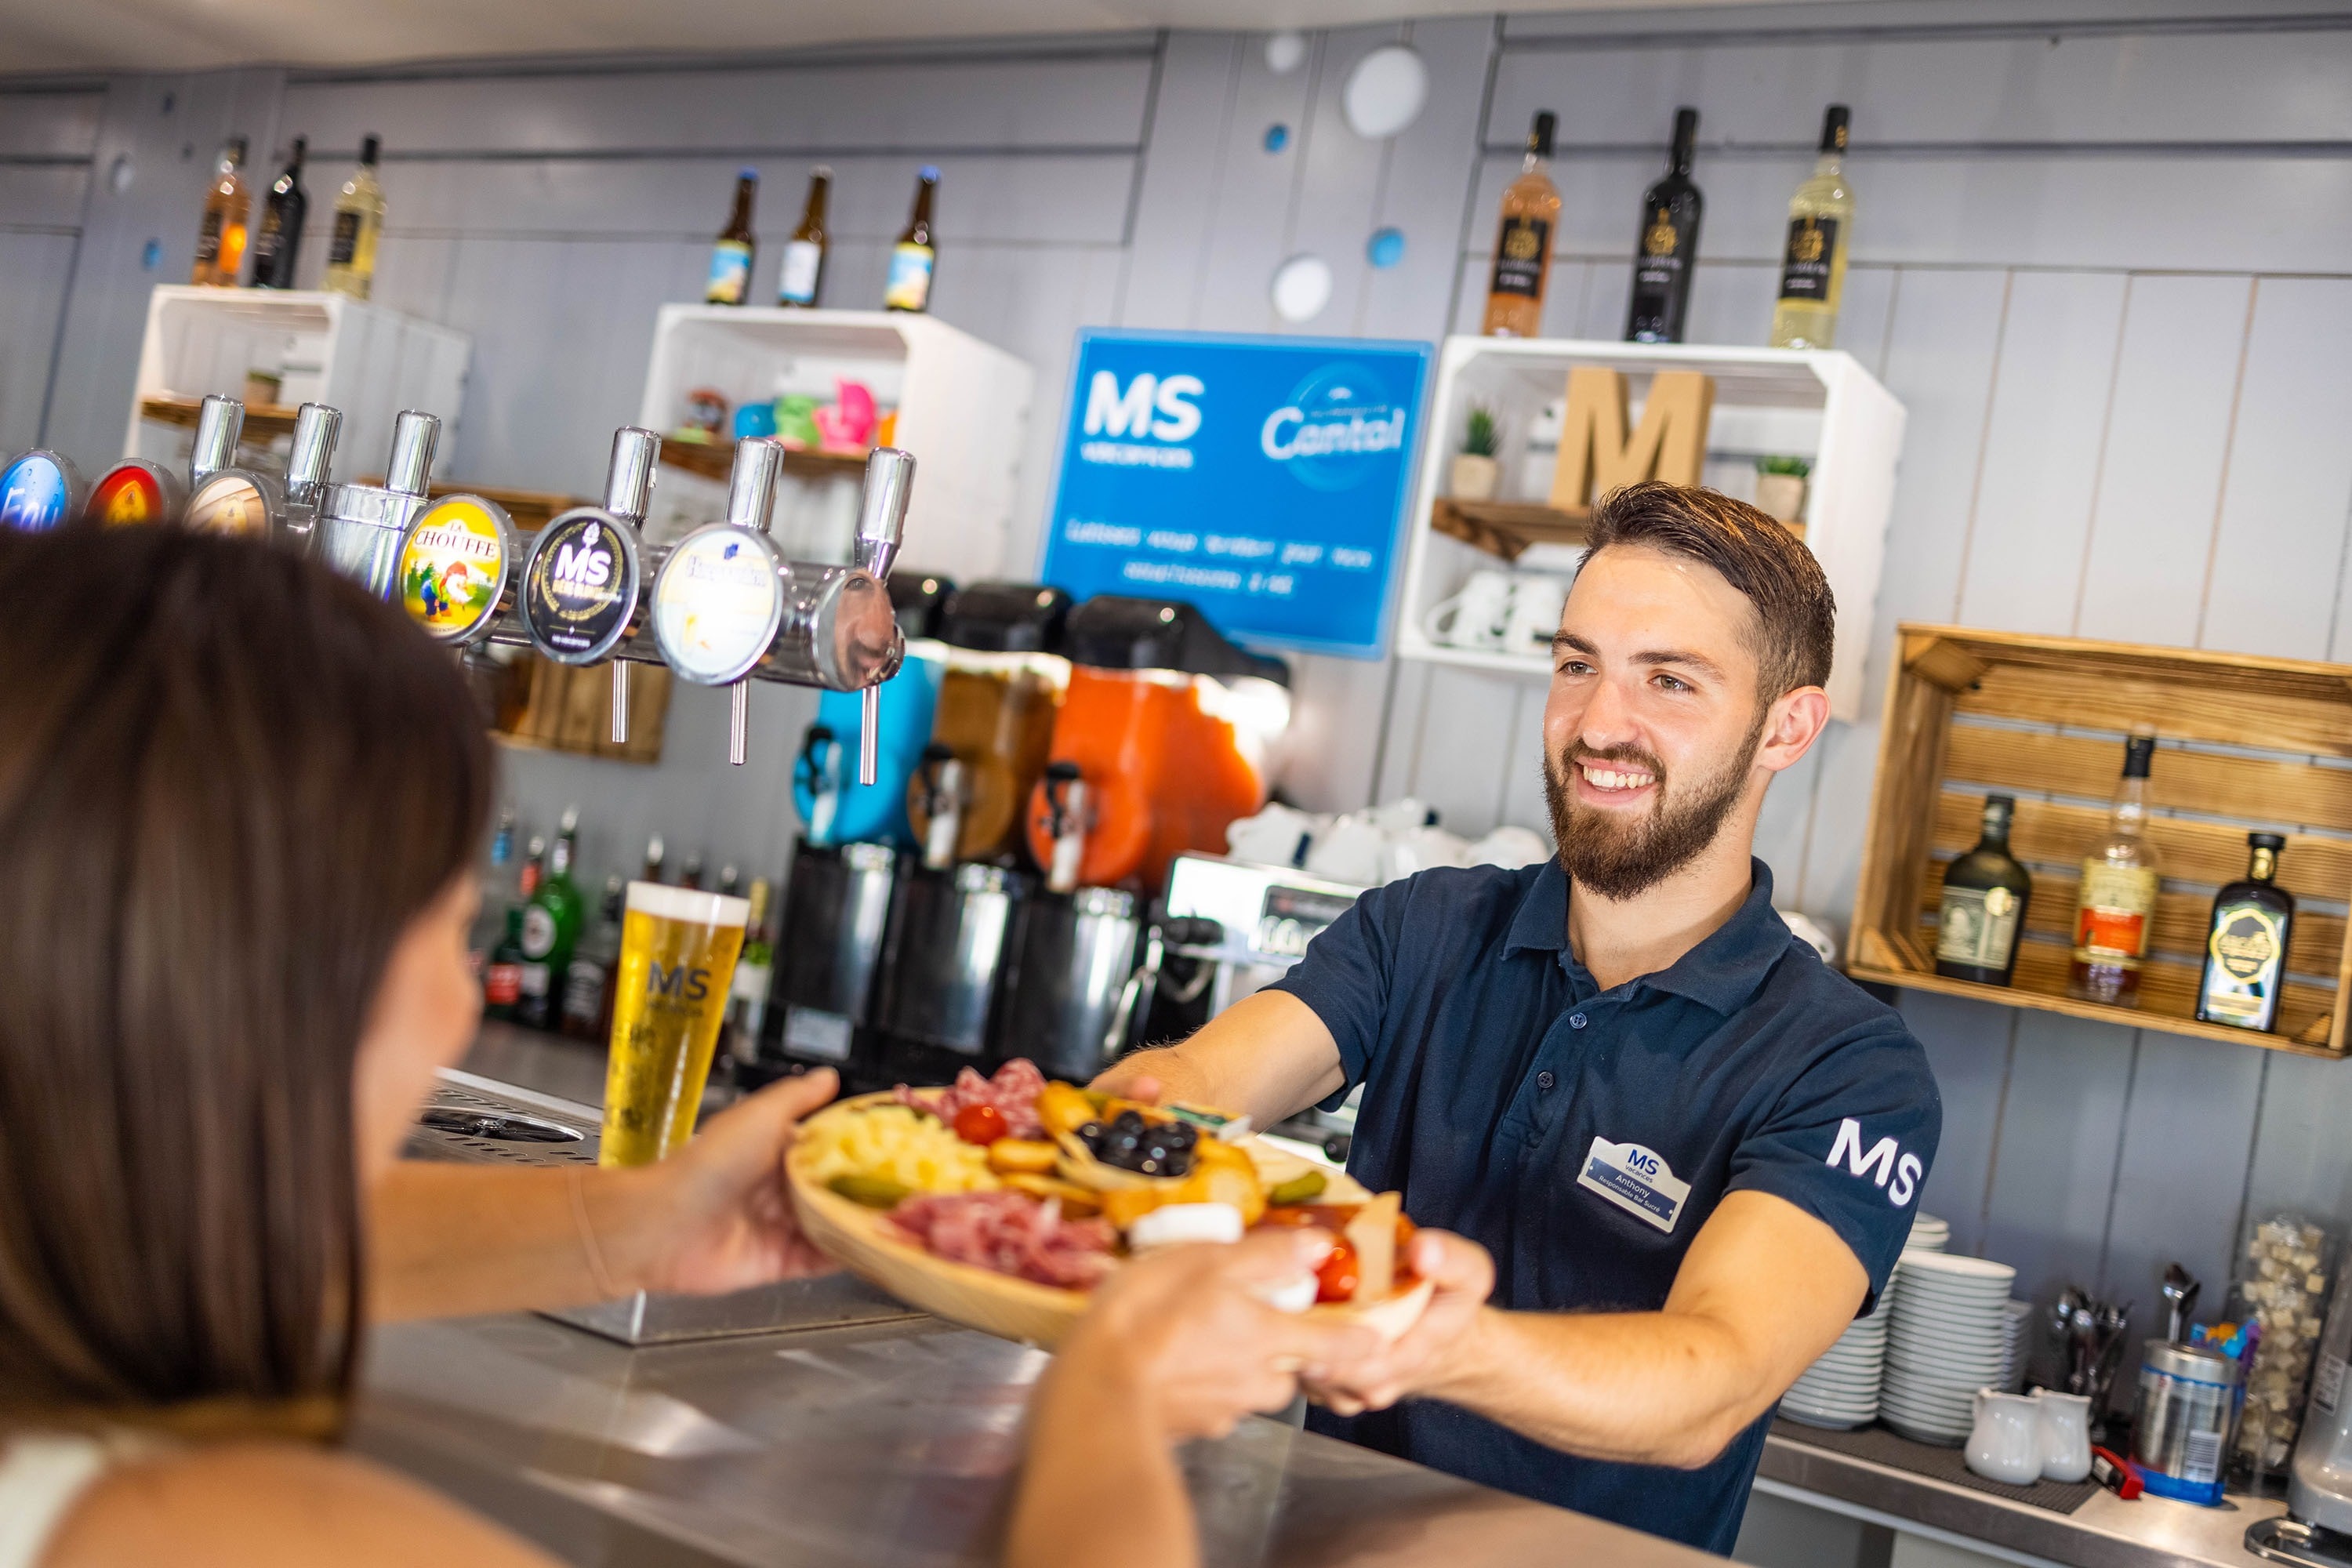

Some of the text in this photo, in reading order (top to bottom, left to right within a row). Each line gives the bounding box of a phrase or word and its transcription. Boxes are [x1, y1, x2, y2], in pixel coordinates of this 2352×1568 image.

[1083, 370, 1206, 442] MS
[1260, 406, 1406, 460] Cantal
[1548, 366, 1716, 514] M
[415, 531, 496, 558] CHOUFFE
[449, 522, 463, 533] LA
[554, 543, 612, 586] MS
[647, 960, 710, 1002] MS
[1625, 1165, 1653, 1183] vacances
[1628, 1149, 1660, 1175] MS
[1825, 1118, 1922, 1206] MS
[1599, 1175, 1661, 1213] Responsable Bar Sucré
[1615, 1174, 1650, 1198] Anthony
